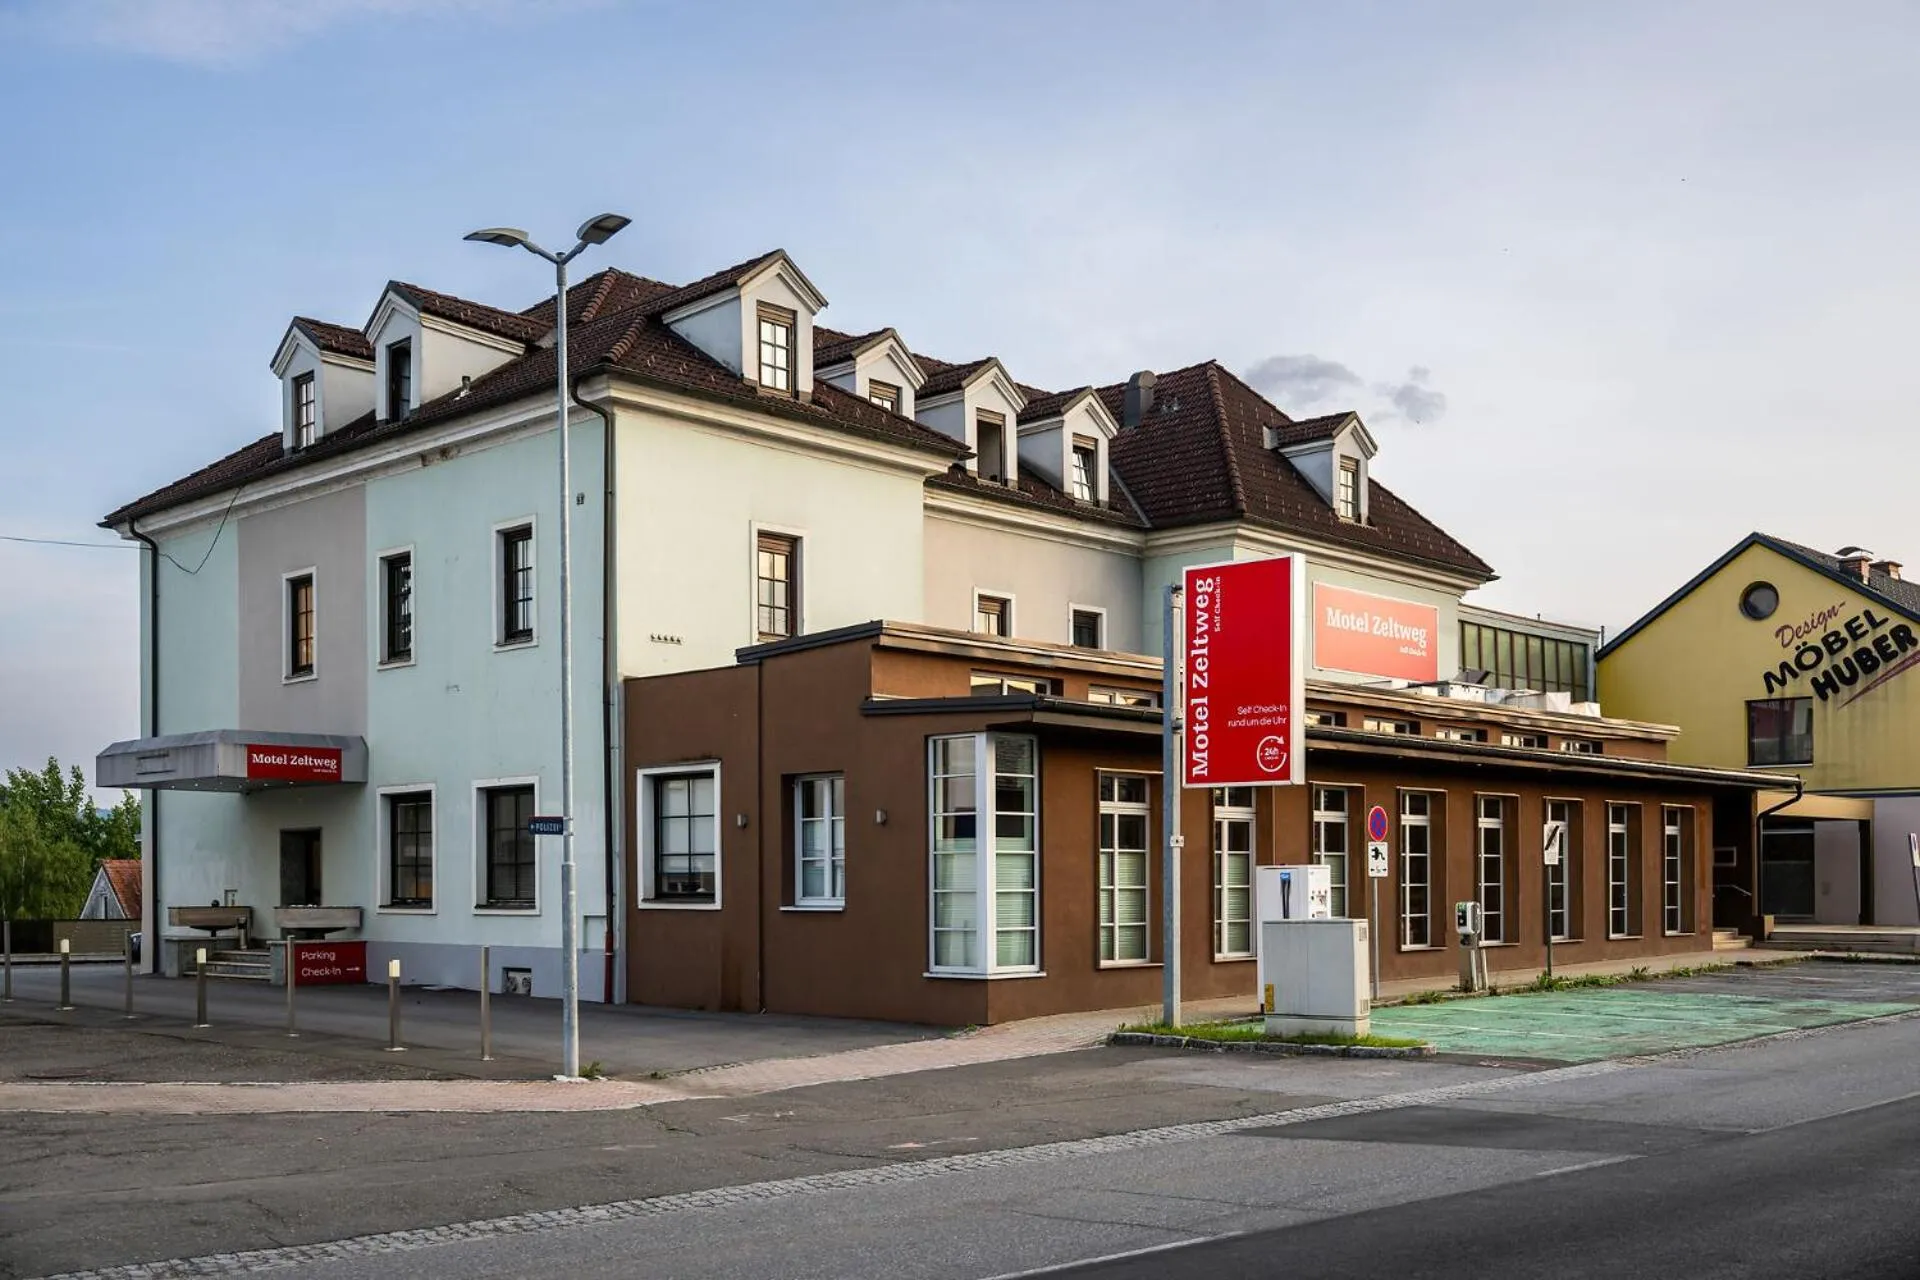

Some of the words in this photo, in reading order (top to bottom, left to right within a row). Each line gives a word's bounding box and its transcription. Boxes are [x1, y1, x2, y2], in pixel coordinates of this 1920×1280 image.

[1191, 577, 1214, 689] Zeltweg
[1325, 606, 1369, 633] Motel
[1372, 616, 1428, 649] Zeltweg
[1775, 601, 1846, 648] Design-
[1763, 609, 1889, 694] MÖBEL
[1811, 624, 1919, 701] HUBER
[1191, 695, 1209, 777] Motel
[1228, 718, 1246, 727] rund
[1272, 716, 1287, 725] Uhr
[252, 753, 288, 765] Motel
[290, 755, 337, 769] Zeltweg
[301, 950, 336, 961] Parking
